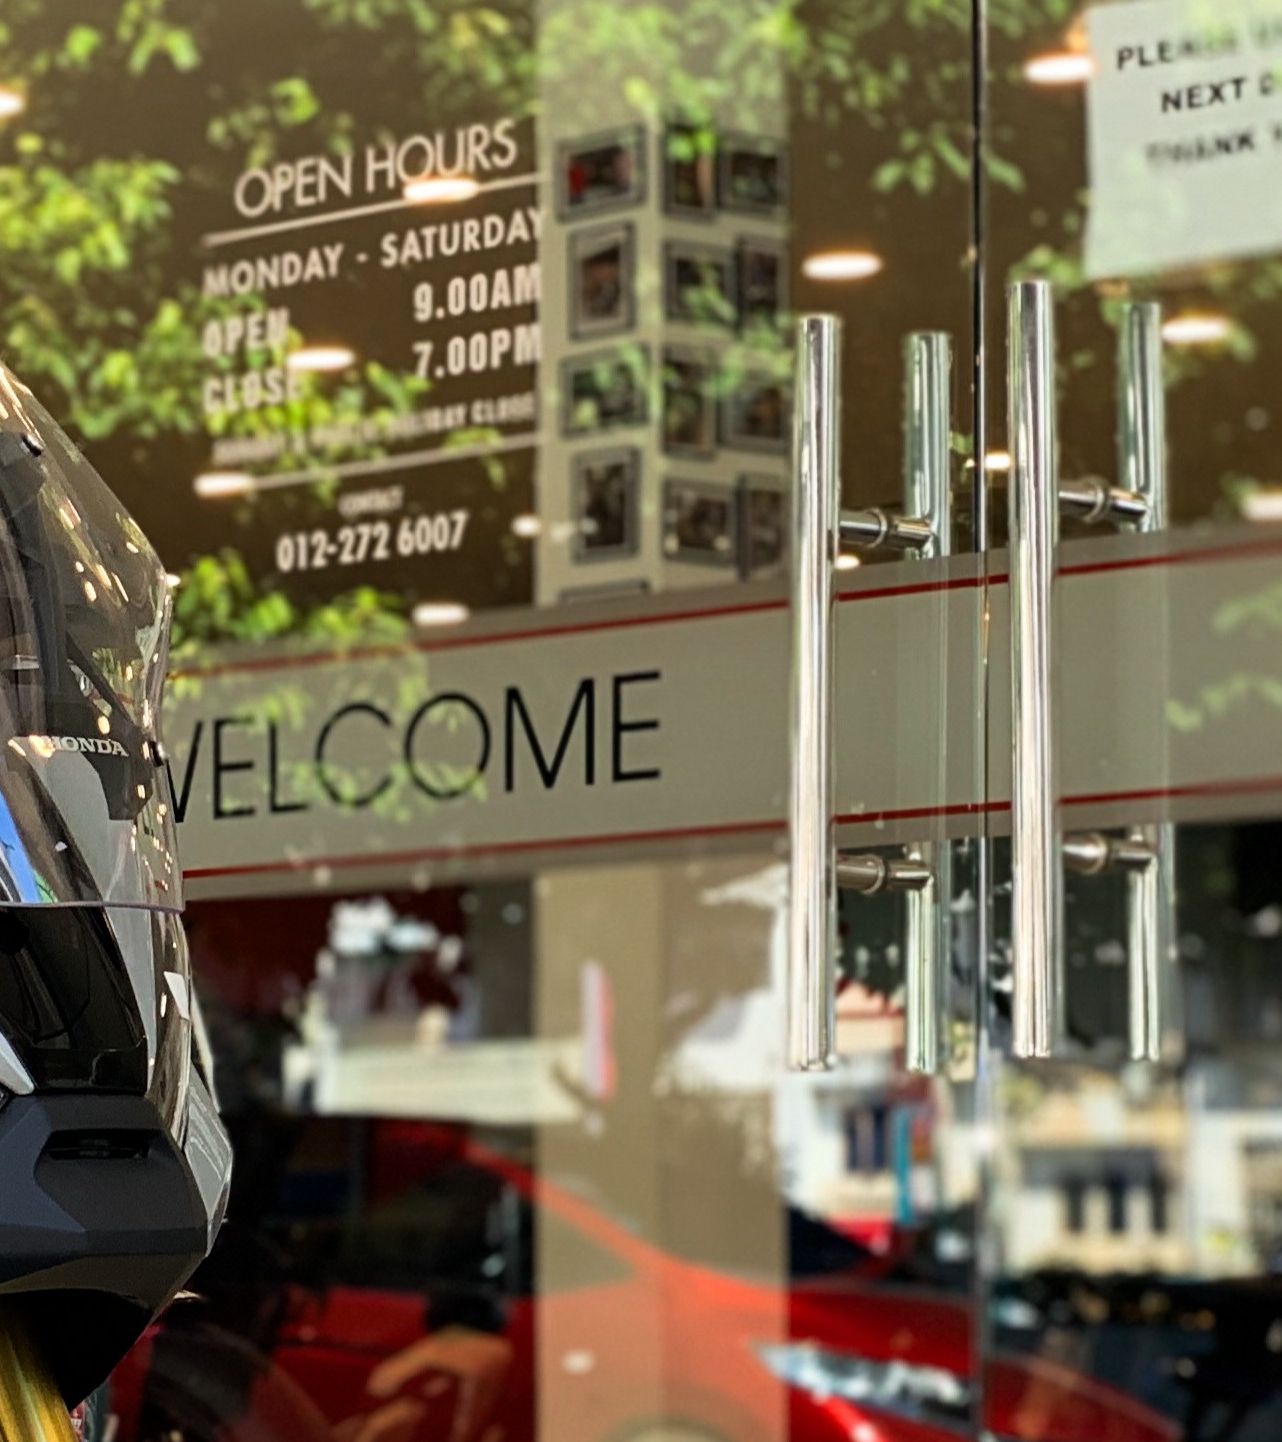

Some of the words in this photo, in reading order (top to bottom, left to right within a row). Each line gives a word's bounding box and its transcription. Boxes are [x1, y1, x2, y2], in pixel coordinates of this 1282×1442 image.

[1117, 25, 1239, 71] PLE
[1161, 76, 1247, 114] NEXT
[235, 155, 353, 218] OPEN
[365, 118, 518, 193] HOURS
[202, 243, 344, 298] MONDAY
[380, 205, 544, 268] SATURDAY
[202, 306, 290, 360] OPEN
[412, 262, 542, 323] 9.00AM
[202, 364, 303, 415] CLOSE
[411, 322, 542, 380] 7.00PM
[276, 520, 391, 572] 012-272
[396, 508, 469, 557] 6007
[42, 734, 130, 758] HONDA
